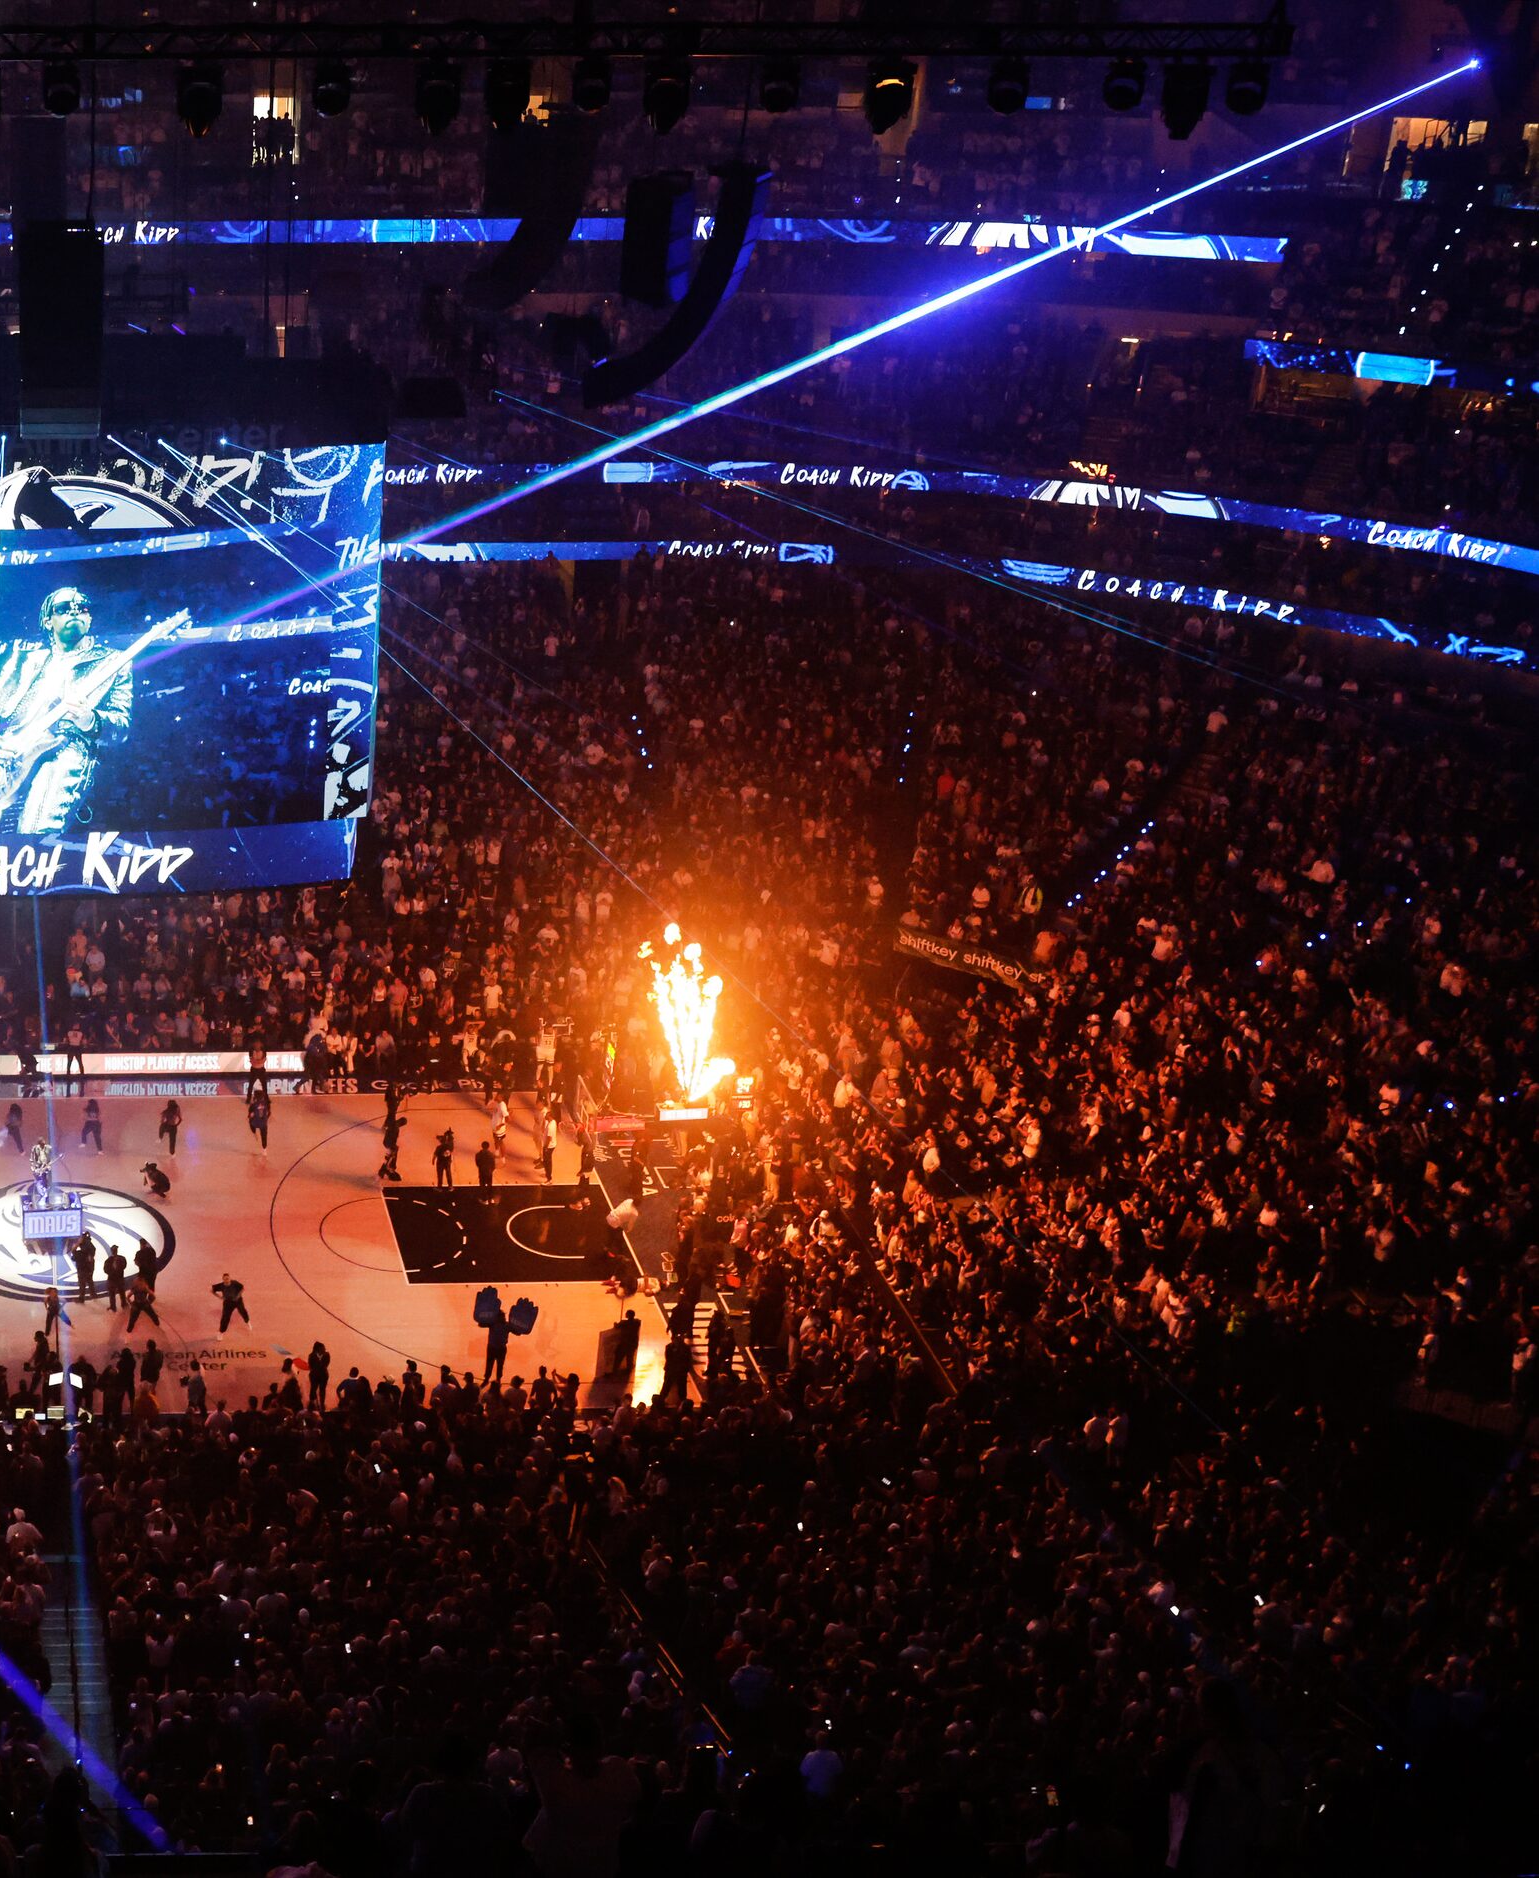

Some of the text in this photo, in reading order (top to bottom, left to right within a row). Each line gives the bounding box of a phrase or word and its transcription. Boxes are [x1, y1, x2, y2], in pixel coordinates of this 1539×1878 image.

[385, 470, 427, 484] OACH
[780, 462, 838, 485] COACH
[1367, 521, 1436, 552] COACH
[1078, 570, 1186, 603] COACH
[898, 933, 958, 962] shiftkey
[963, 951, 1024, 981] shiftkey
[104, 1056, 145, 1071] NONSTOP
[147, 1055, 183, 1070] PLAYOFF
[198, 1348, 267, 1359] Airlines
[167, 1361, 228, 1371] Ceter
